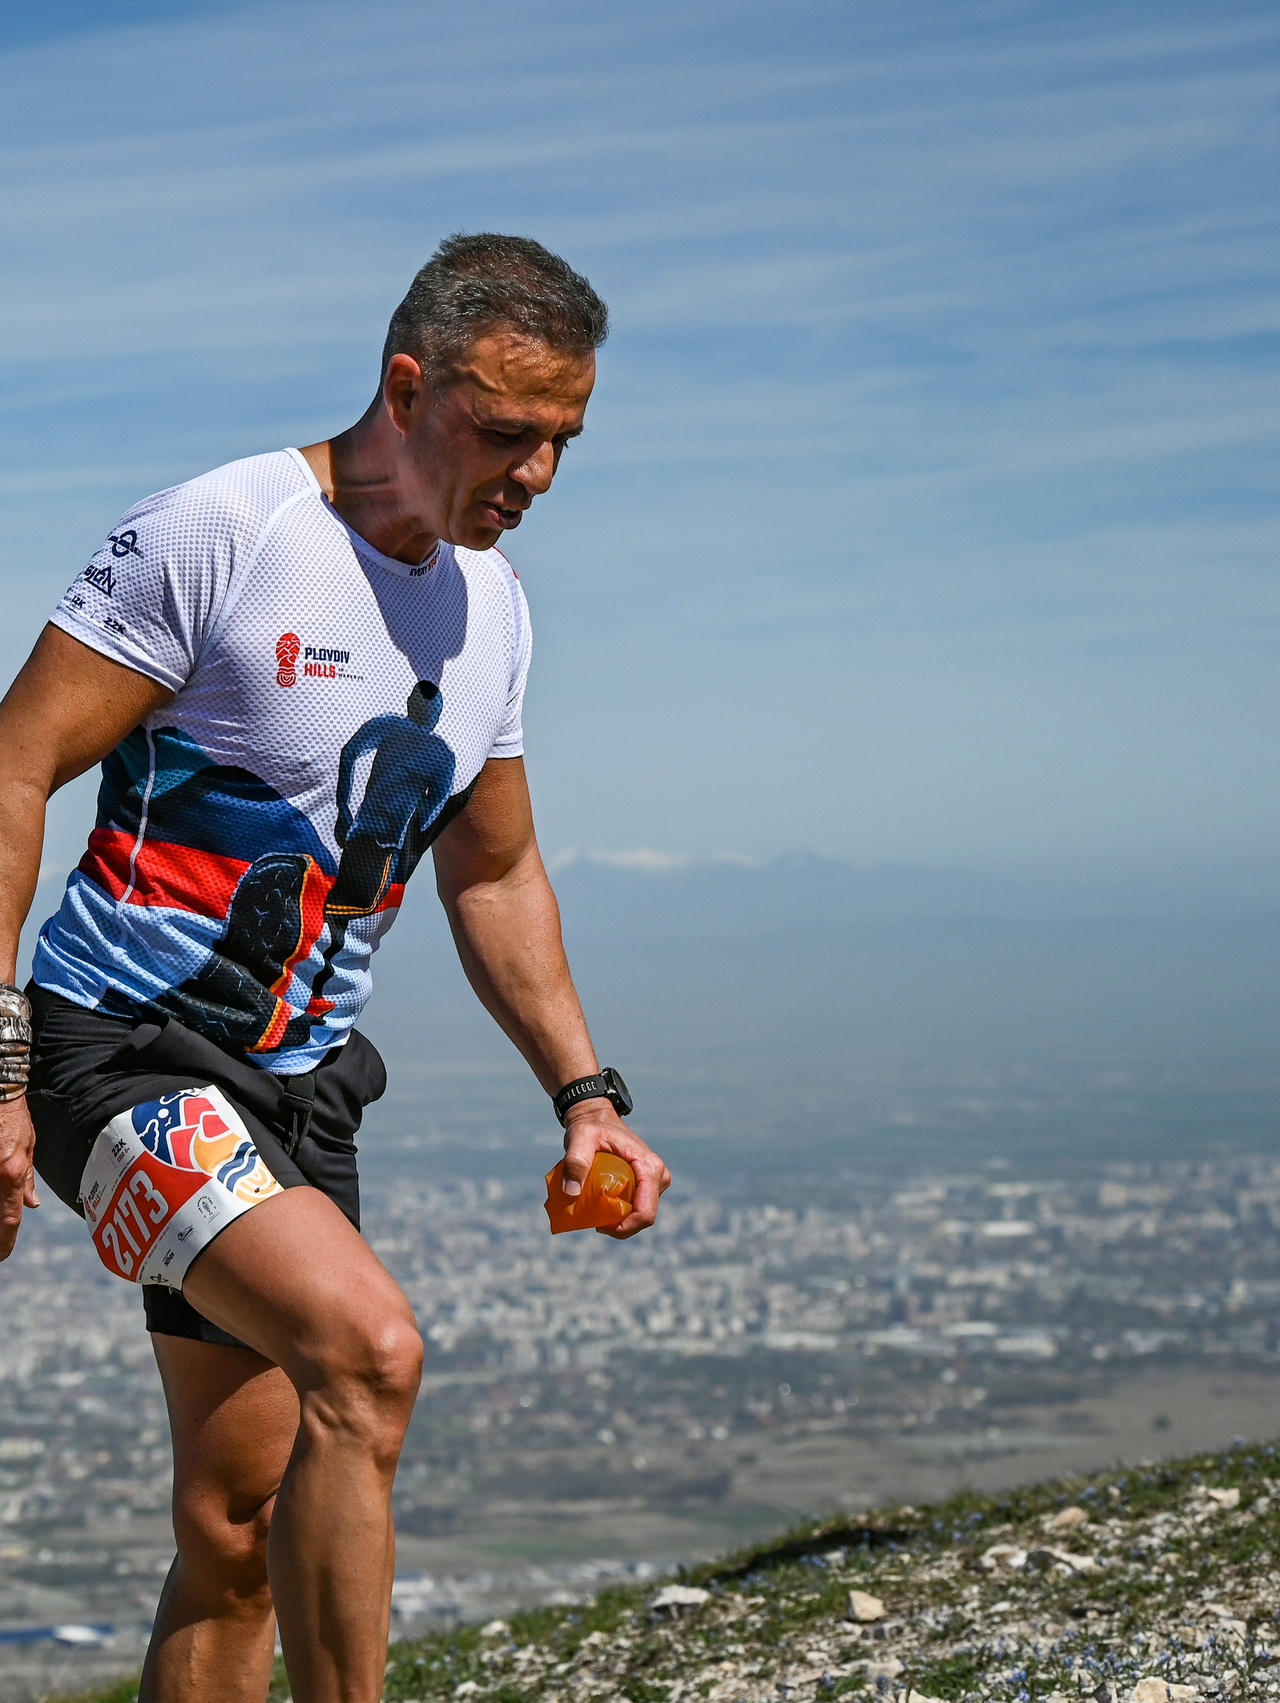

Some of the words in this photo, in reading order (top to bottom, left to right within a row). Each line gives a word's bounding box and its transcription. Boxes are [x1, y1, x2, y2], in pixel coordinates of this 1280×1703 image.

[104, 617, 126, 635] 22K
[304, 647, 350, 664] PLOVDIV
[304, 663, 336, 678] HILLS
[111, 1138, 127, 1158] 22K
[101, 1170, 169, 1276] 2173
